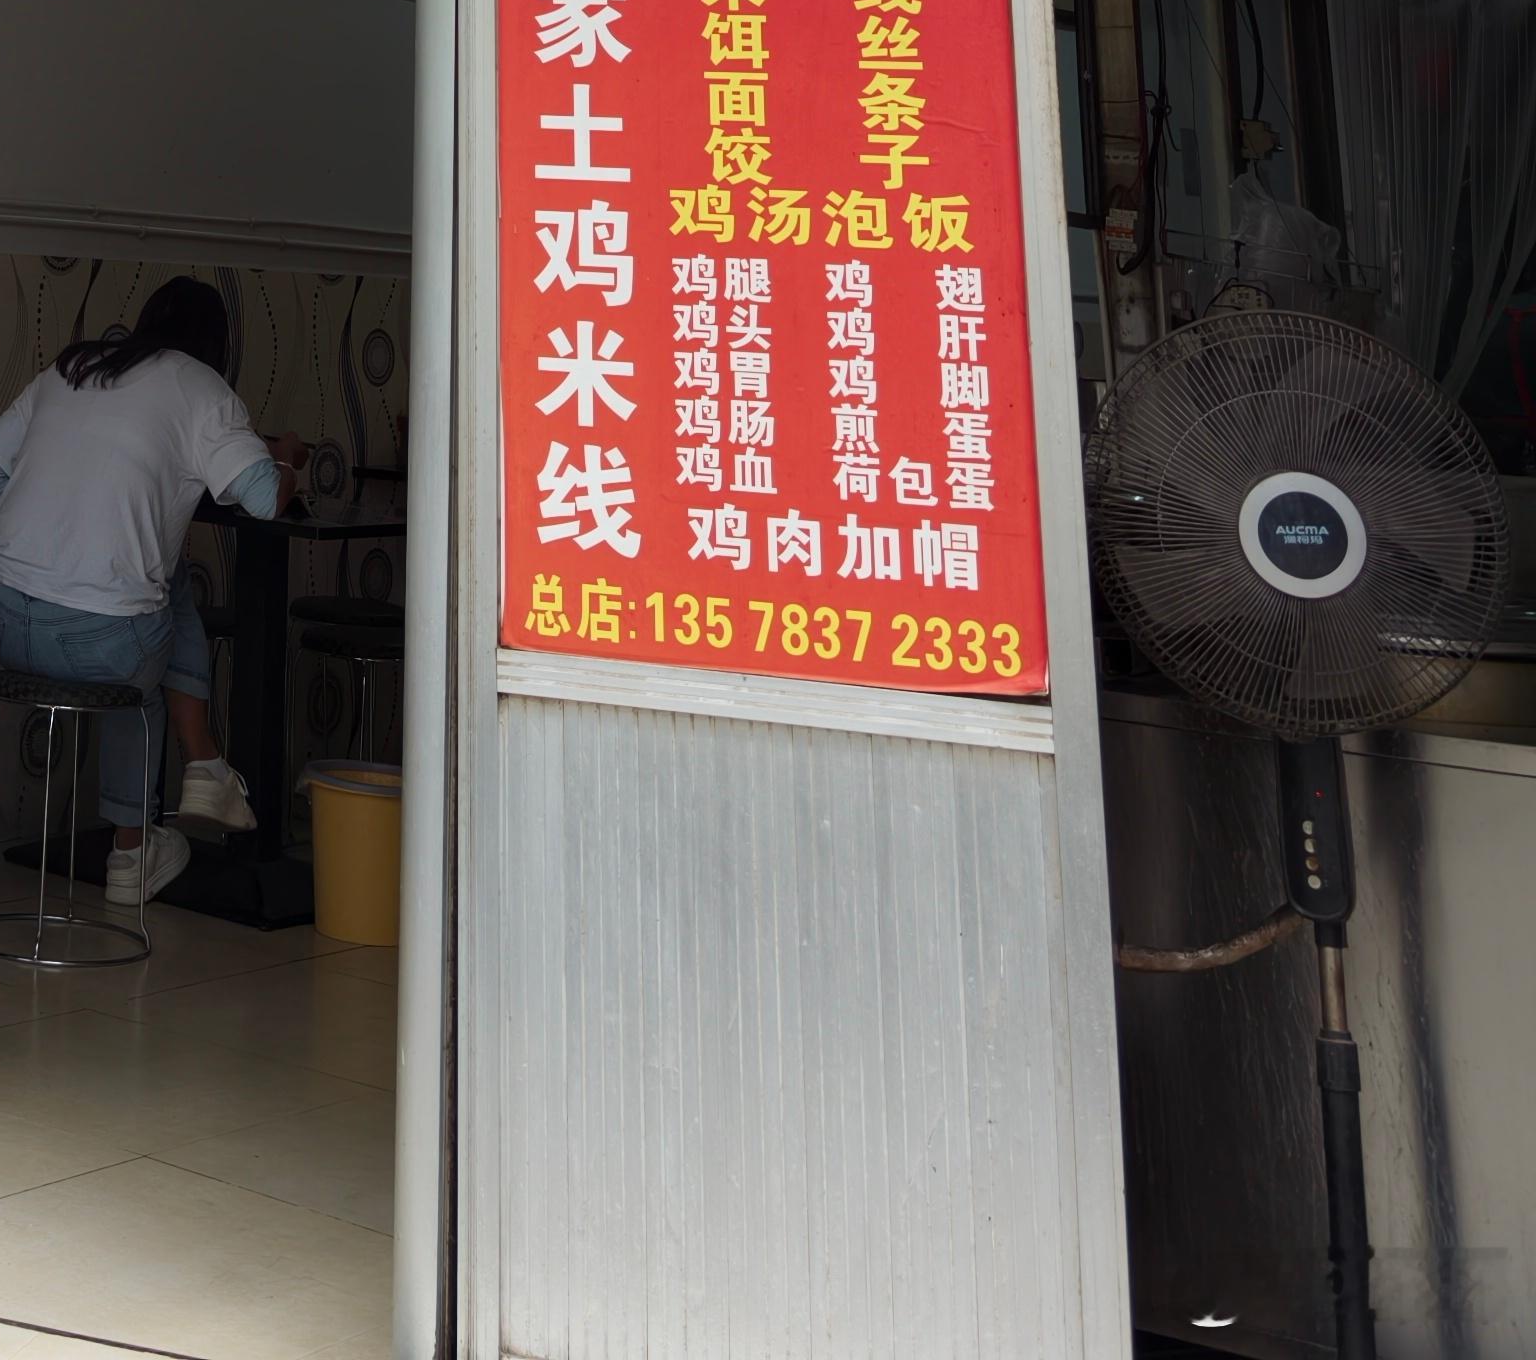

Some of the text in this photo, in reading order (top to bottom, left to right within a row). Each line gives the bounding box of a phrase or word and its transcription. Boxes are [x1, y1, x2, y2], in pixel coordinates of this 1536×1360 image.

[669, 183, 975, 253] 鸡汤泡饭
[671, 254, 986, 313] 鸡腿 鸡翅
[672, 300, 987, 361] 鸡头 鸡肝
[673, 347, 990, 411] 鸡胃 鸡脚
[674, 394, 992, 462] 鸡肠 煎蛋
[675, 443, 995, 512] 鸡血 荷包蛋
[687, 502, 979, 591] 鸡肉加帽
[1275, 525, 1329, 535] AUCMA
[746, 600, 873, 662] 7837
[890, 613, 1022, 677] 2333
